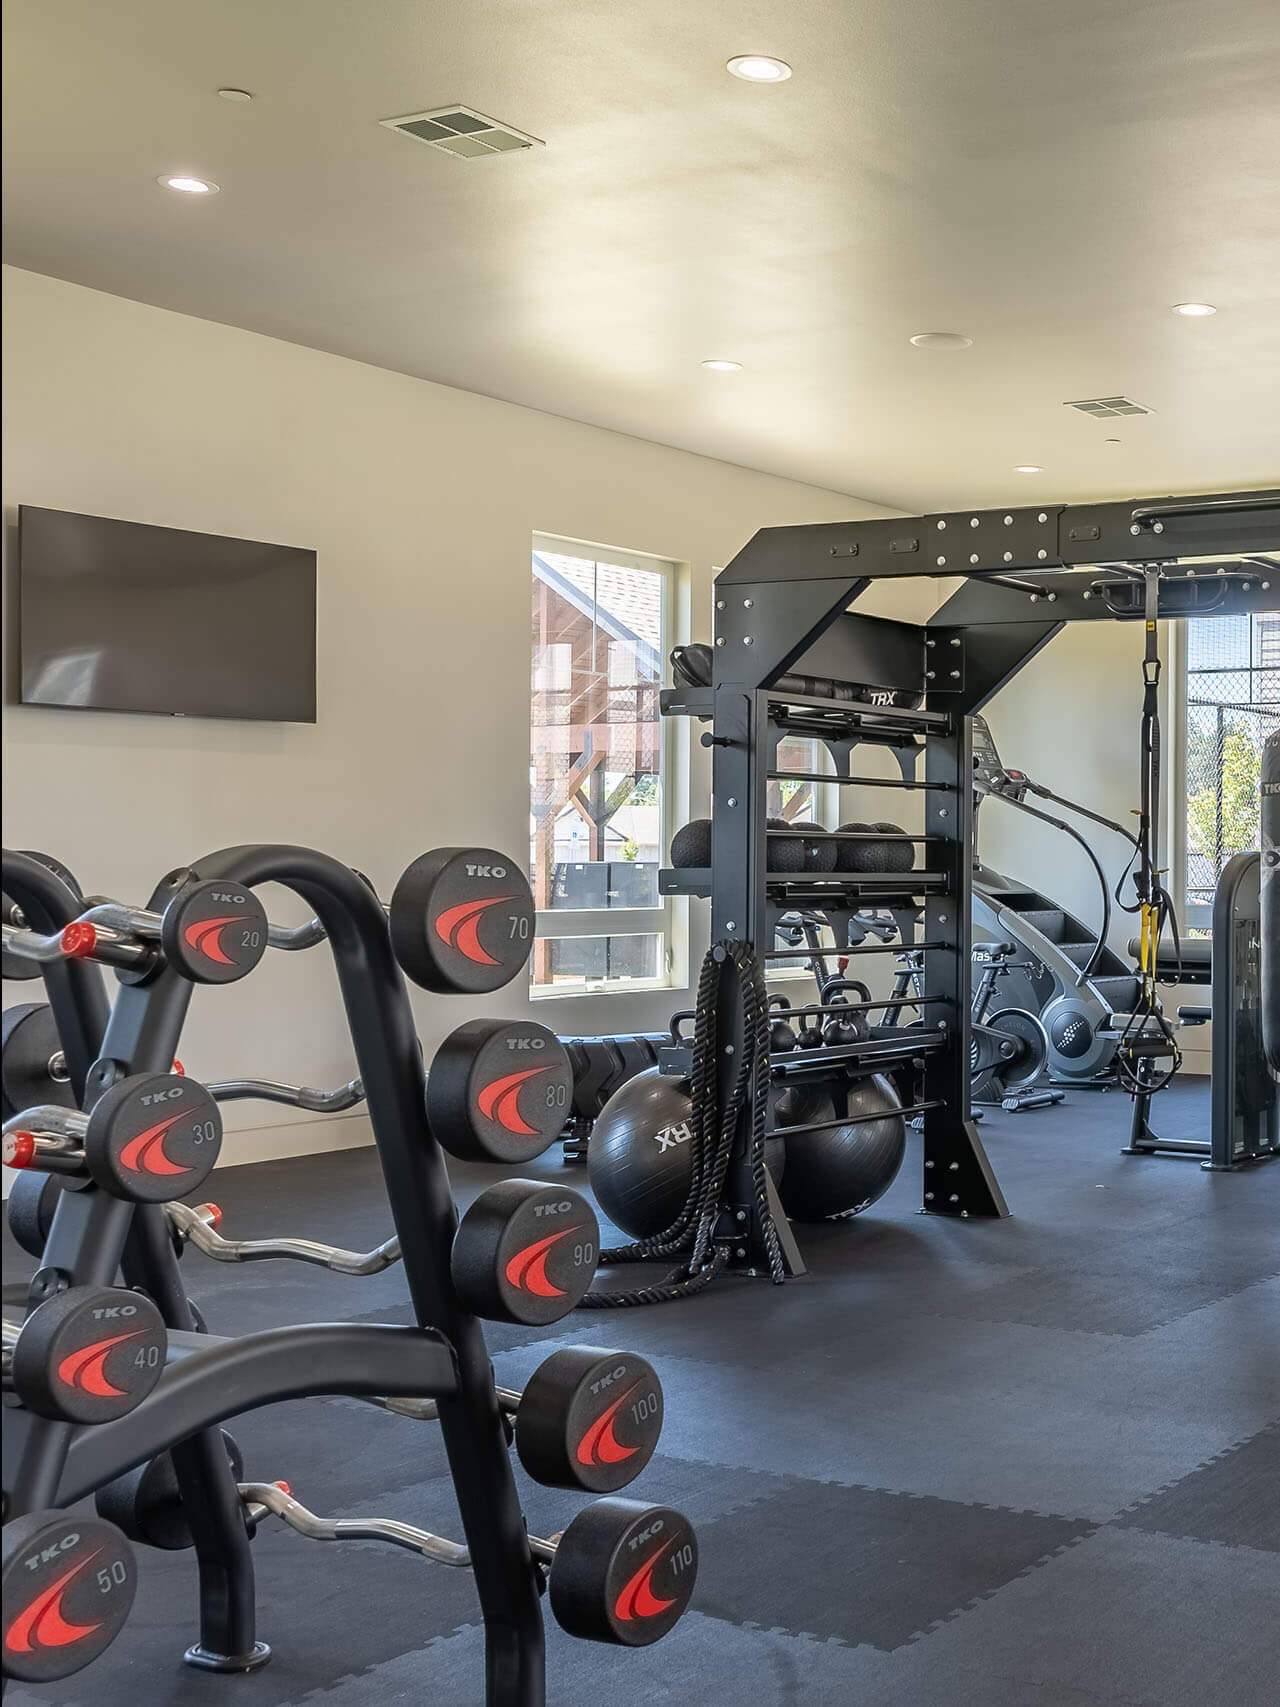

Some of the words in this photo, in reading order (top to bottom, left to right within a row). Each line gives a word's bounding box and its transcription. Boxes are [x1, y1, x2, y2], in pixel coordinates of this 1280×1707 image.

[870, 691, 897, 706] TRX
[465, 864, 507, 878] TKO
[211, 892, 246, 904] TKO
[508, 915, 529, 939] 70
[241, 931, 260, 947] 20
[506, 1038, 546, 1050] TKO
[140, 1087, 185, 1106] TKO
[546, 1085, 566, 1107] 80
[192, 1121, 216, 1145] 30
[654, 1122, 693, 1154] RX
[534, 1201, 572, 1217] TKO
[574, 1242, 593, 1266] 90
[92, 1305, 138, 1320] TKO
[134, 1346, 159, 1369] 40
[589, 1366, 627, 1394] TKO
[631, 1393, 657, 1425] 100
[628, 1520, 664, 1550] TKO
[24, 1533, 81, 1571] TKO
[670, 1545, 693, 1575] 110
[96, 1560, 127, 1593] 50
